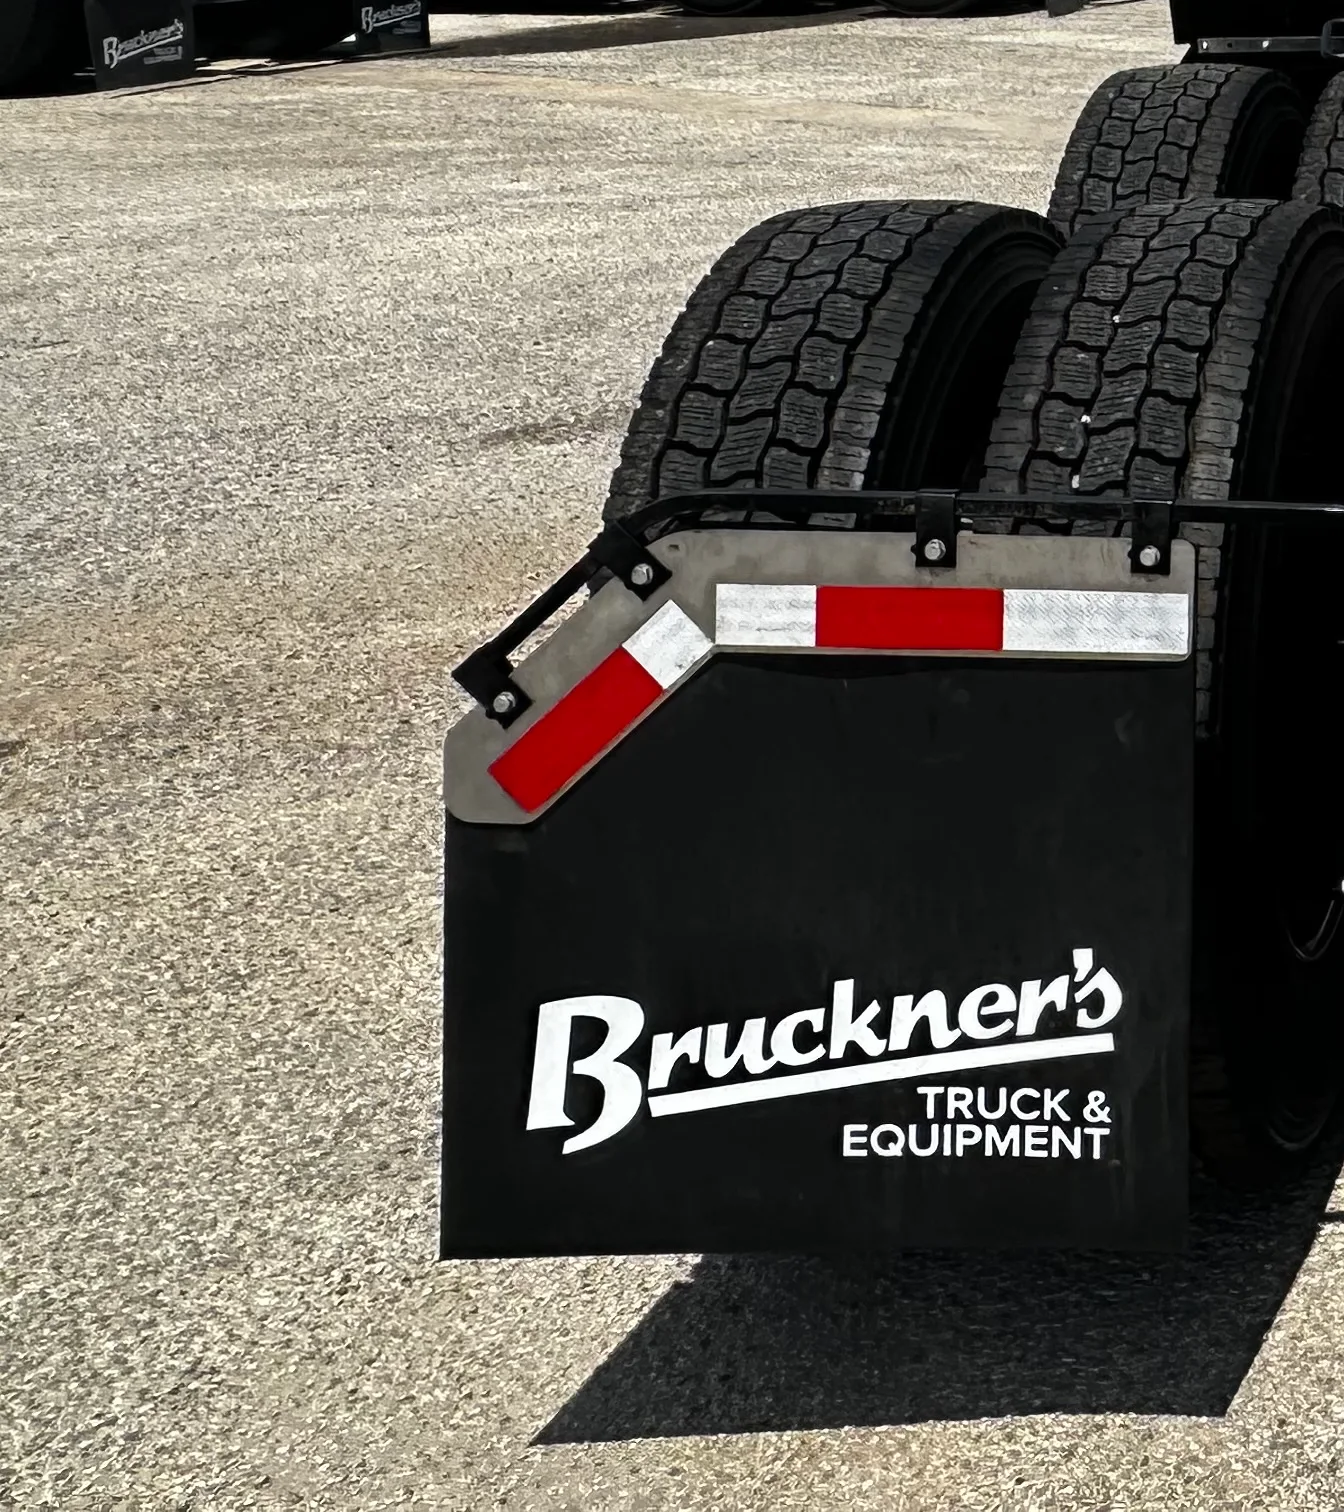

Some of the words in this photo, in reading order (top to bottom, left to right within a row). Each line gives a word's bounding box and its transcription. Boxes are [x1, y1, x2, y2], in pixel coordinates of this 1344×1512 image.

[525, 947, 1123, 1155] Bruckner's
[916, 1086, 1072, 1122] TRUCK
[1083, 1090, 1113, 1124] &
[842, 1123, 1112, 1160] EQUIPMENT
